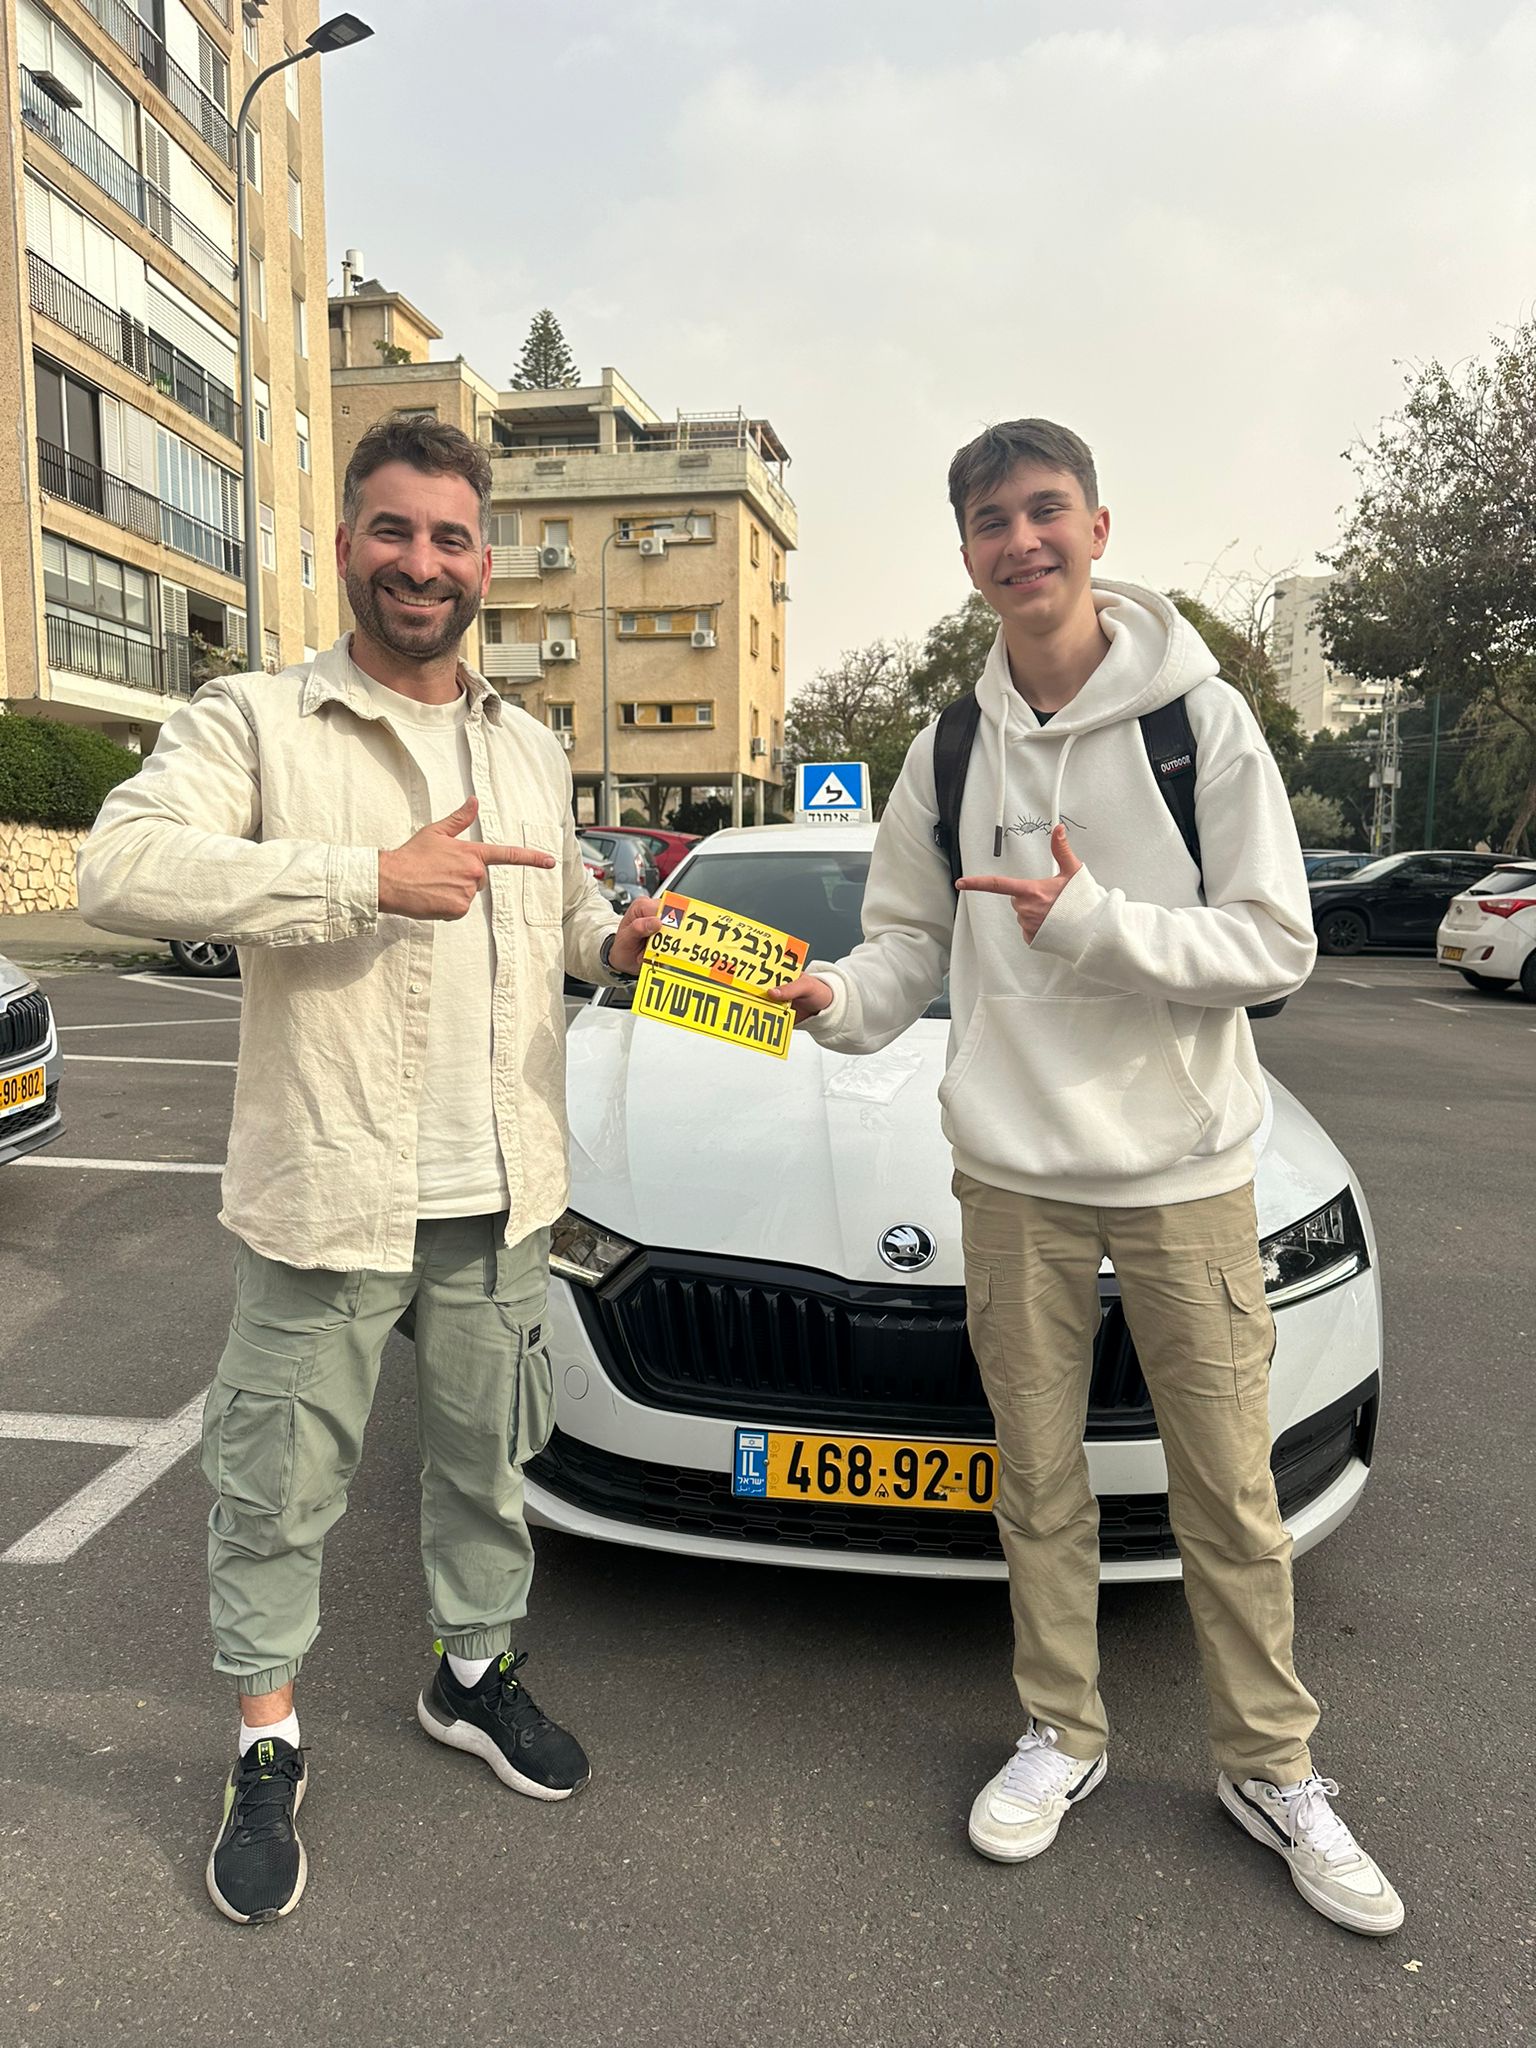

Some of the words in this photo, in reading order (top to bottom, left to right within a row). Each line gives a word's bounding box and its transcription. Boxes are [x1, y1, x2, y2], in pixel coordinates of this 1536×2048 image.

[1160, 754, 1192, 773] OUTDOOR
[825, 784, 843, 804] ל
[808, 812, 849, 822] איחוד
[687, 912, 799, 972] בונבידה
[651, 932, 757, 982] 054-5493277
[645, 977, 720, 1028] חדש/ה
[722, 1001, 785, 1048] נהג/ת
[742, 1451, 760, 1476] IL
[737, 1476, 765, 1485] ישראל
